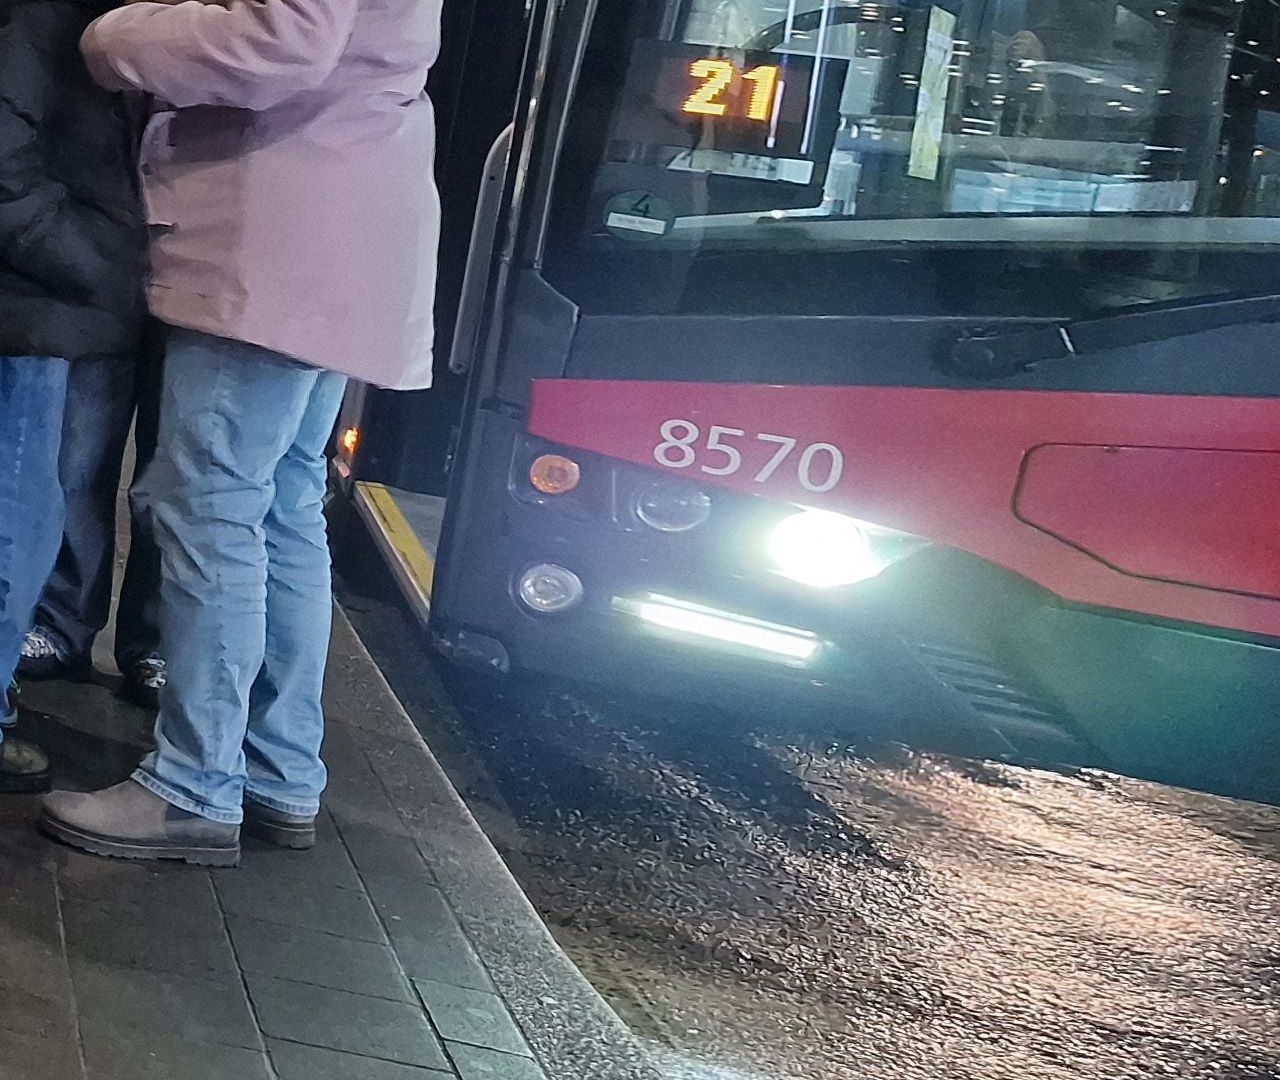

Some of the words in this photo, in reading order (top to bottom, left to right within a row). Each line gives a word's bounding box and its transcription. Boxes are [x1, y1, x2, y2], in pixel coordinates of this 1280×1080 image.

[681, 58, 780, 122] 21
[630, 193, 651, 217] 4
[653, 419, 844, 493] 8570
